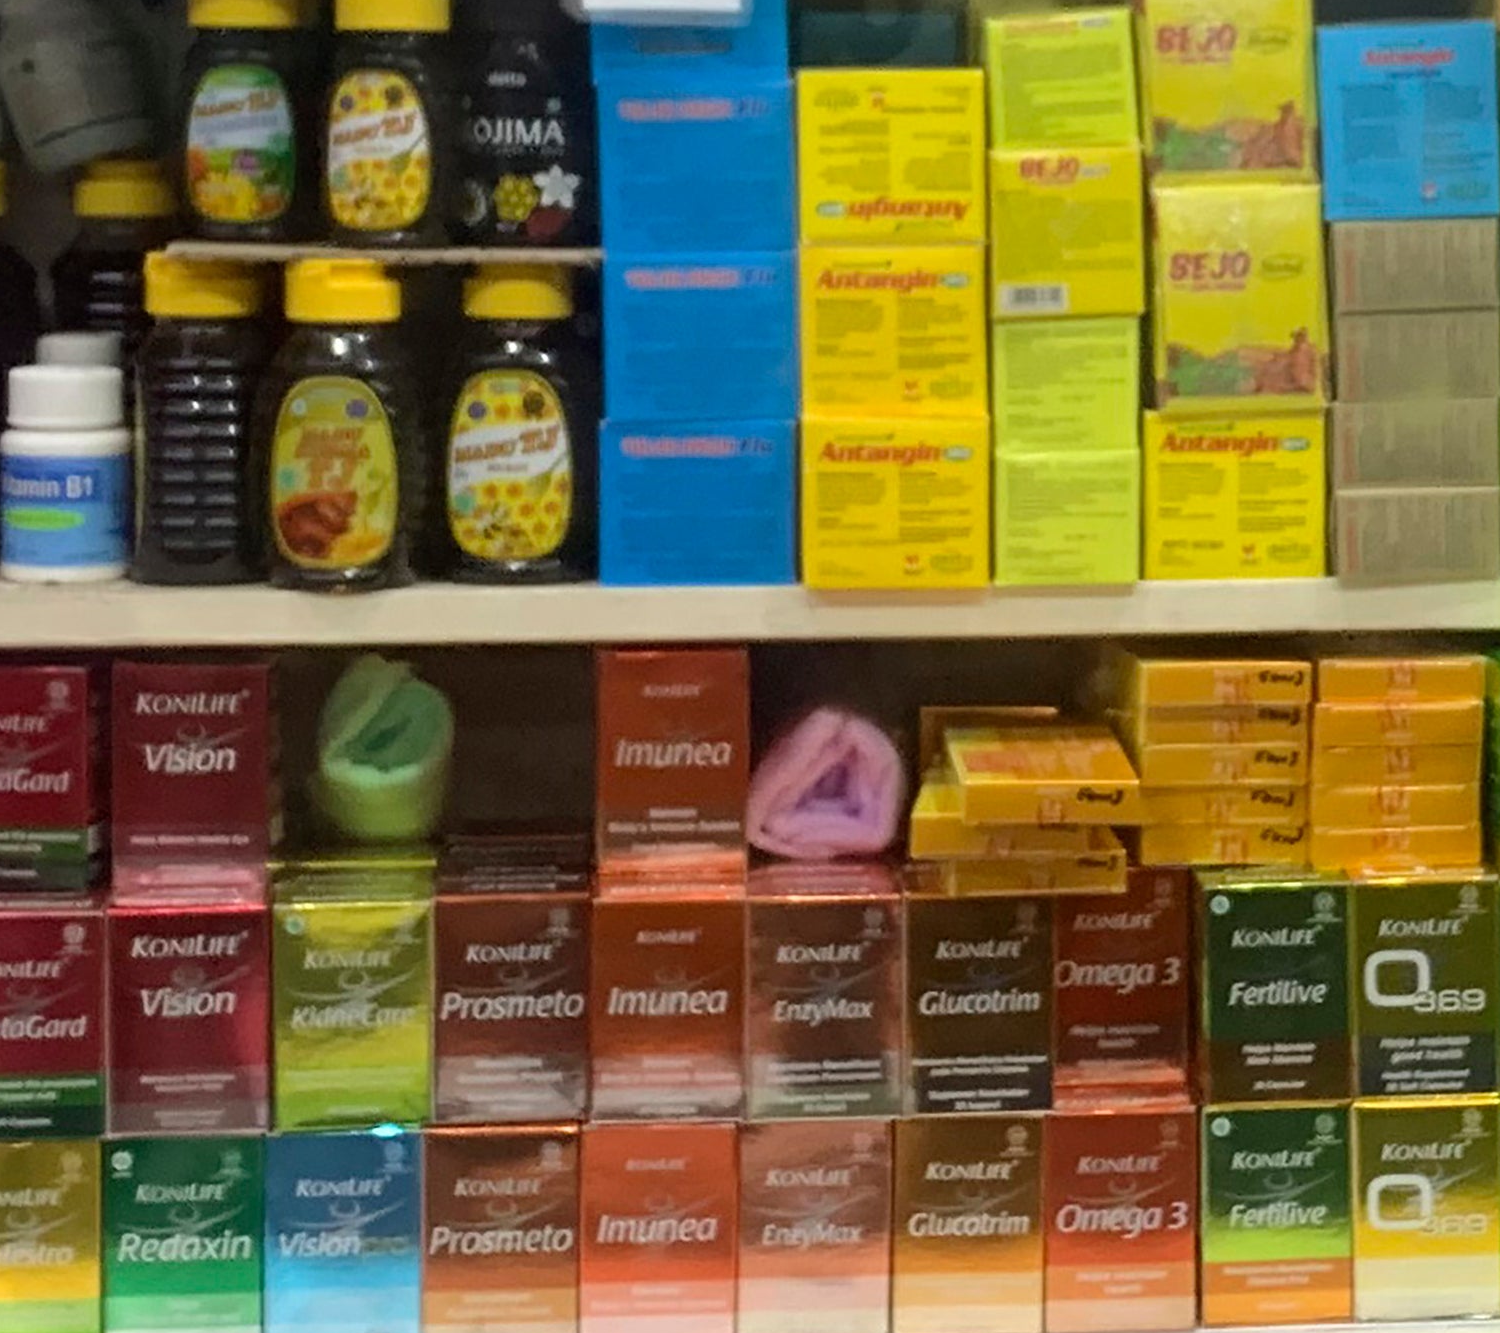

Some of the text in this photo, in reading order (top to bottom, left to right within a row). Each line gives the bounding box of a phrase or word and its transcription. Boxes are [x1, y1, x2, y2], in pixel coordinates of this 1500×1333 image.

[1156, 24, 1236, 55] BEJO
[1019, 157, 1079, 181] BEJO
[816, 268, 939, 295] Antangin
[1168, 252, 1250, 282] BEJO
[819, 441, 942, 466] Antangin
[1160, 430, 1279, 457] Antangin
[67, 475, 93, 498] B1
[143, 743, 238, 775] Vision
[615, 737, 732, 768] Imunea
[140, 988, 236, 1018] Vision
[440, 991, 585, 1022] Prosmeto
[608, 986, 728, 1017] Imunea
[919, 988, 1041, 1016] Glucotrim
[1228, 980, 1327, 1007] Fertilive
[773, 997, 874, 1027] EnzyMax
[597, 1213, 718, 1244] Imunea
[908, 1211, 1030, 1238] Glucotrim
[1056, 1202, 1188, 1236] Omega 3
[1229, 1203, 1327, 1228] Fertilive
[117, 1230, 253, 1264] Redaxin
[279, 1231, 362, 1258] Vision
[429, 1224, 574, 1256] Prosmeto
